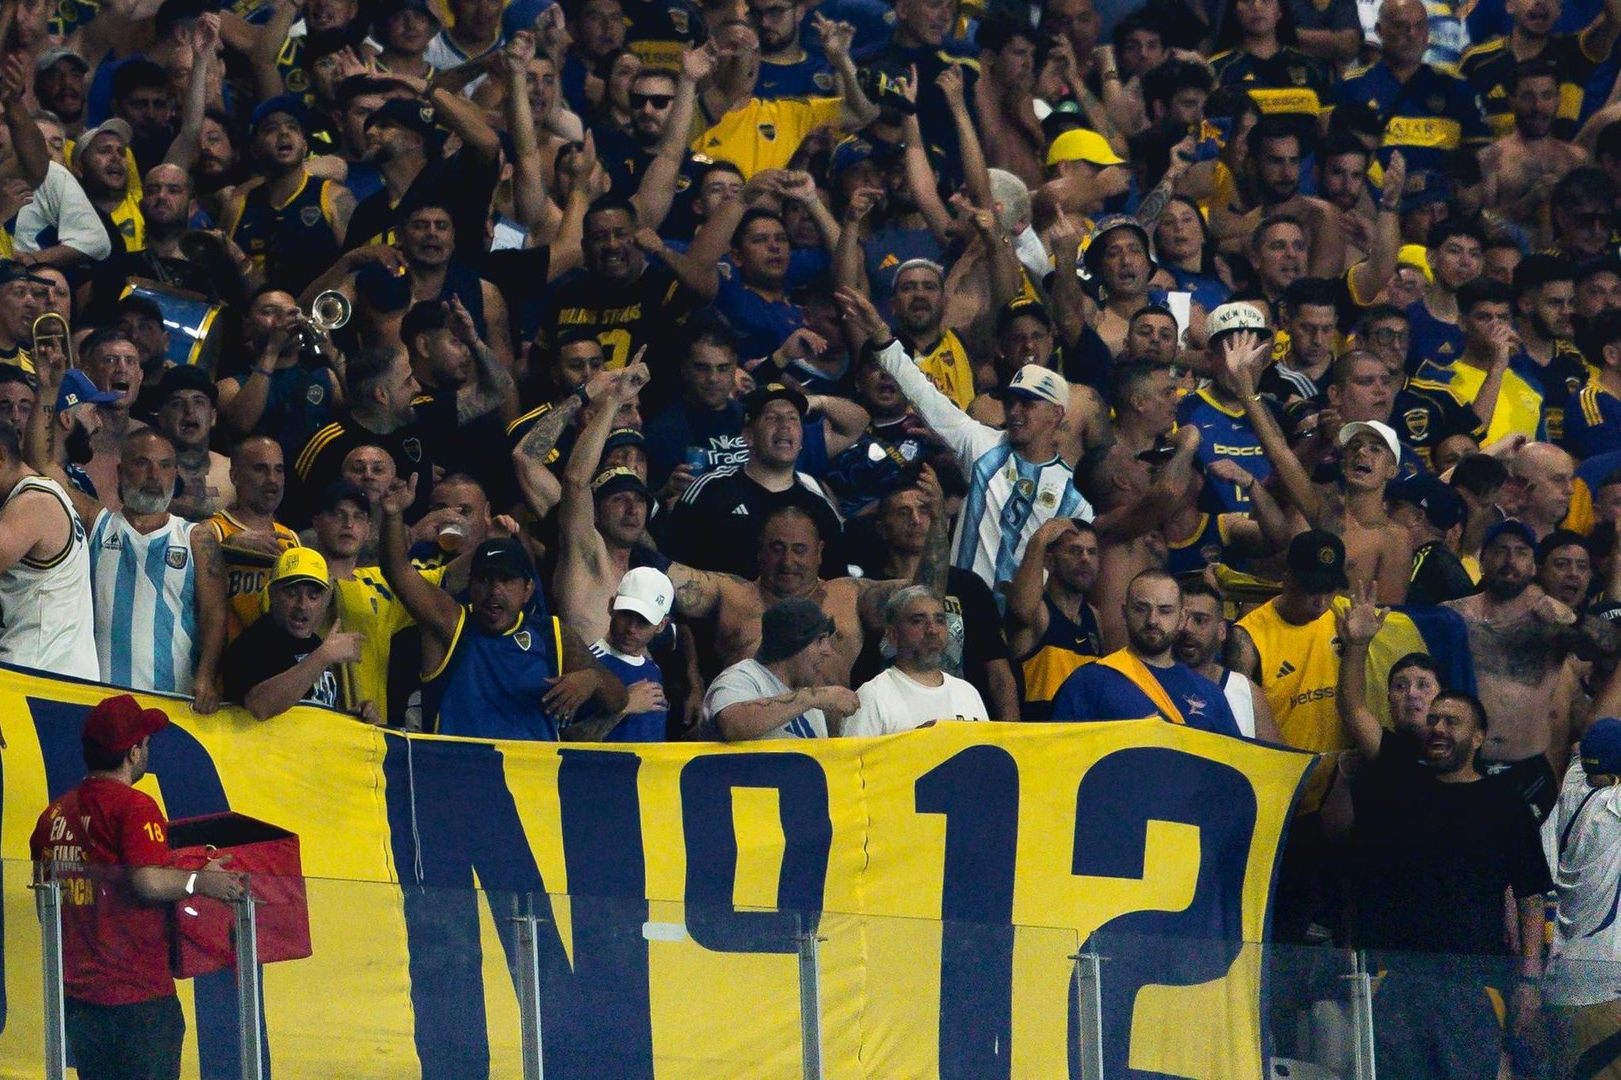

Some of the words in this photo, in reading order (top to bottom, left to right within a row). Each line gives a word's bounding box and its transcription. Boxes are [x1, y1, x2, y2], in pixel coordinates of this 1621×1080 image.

[1220, 309, 1239, 323] NEW
[143, 821, 165, 843] 18
[913, 745, 1258, 1080] 12
